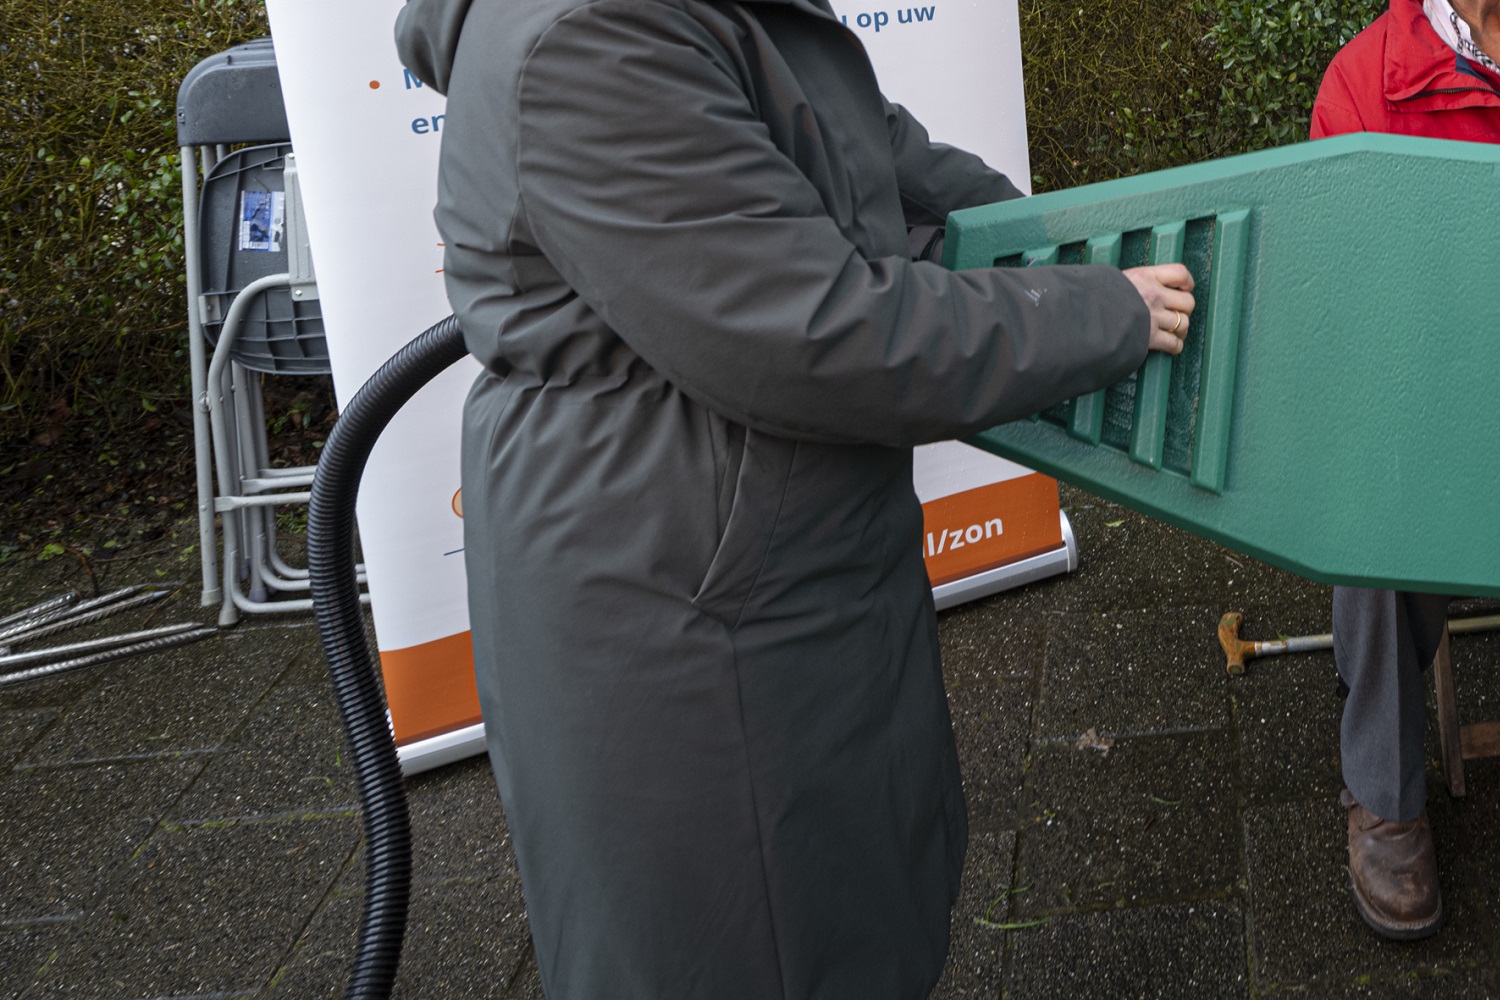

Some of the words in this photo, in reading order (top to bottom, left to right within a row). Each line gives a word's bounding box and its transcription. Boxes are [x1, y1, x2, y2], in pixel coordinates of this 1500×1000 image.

[856, 10, 889, 32] op
[897, 5, 936, 25] uw
[923, 517, 1004, 558] l/zon
